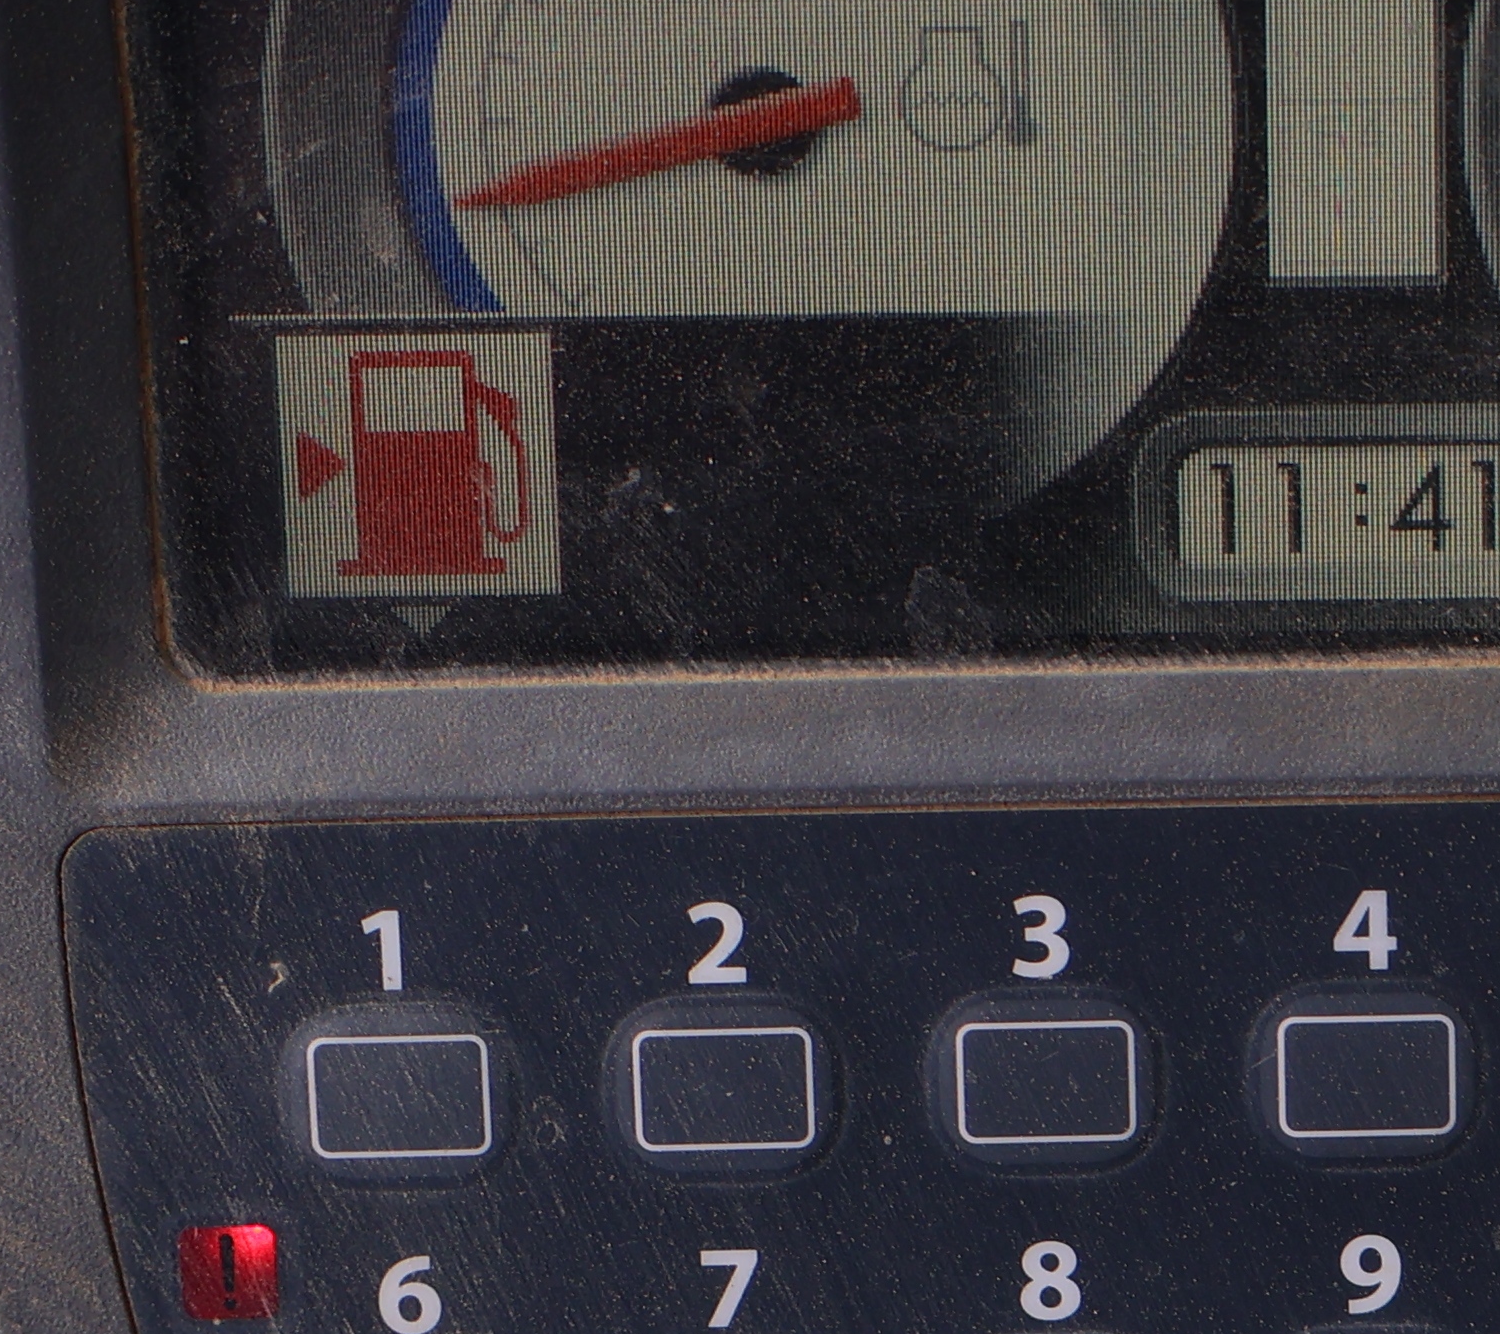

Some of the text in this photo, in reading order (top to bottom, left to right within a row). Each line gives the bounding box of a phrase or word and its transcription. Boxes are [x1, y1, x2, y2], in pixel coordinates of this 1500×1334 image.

[361, 910, 403, 991] 1
[688, 902, 747, 985] 2
[1011, 895, 1071, 979] 3
[1332, 890, 1397, 969] 4
[700, 1249, 759, 1327] 7
[1020, 1242, 1081, 1322] 8
[1339, 1234, 1402, 1314] 9
